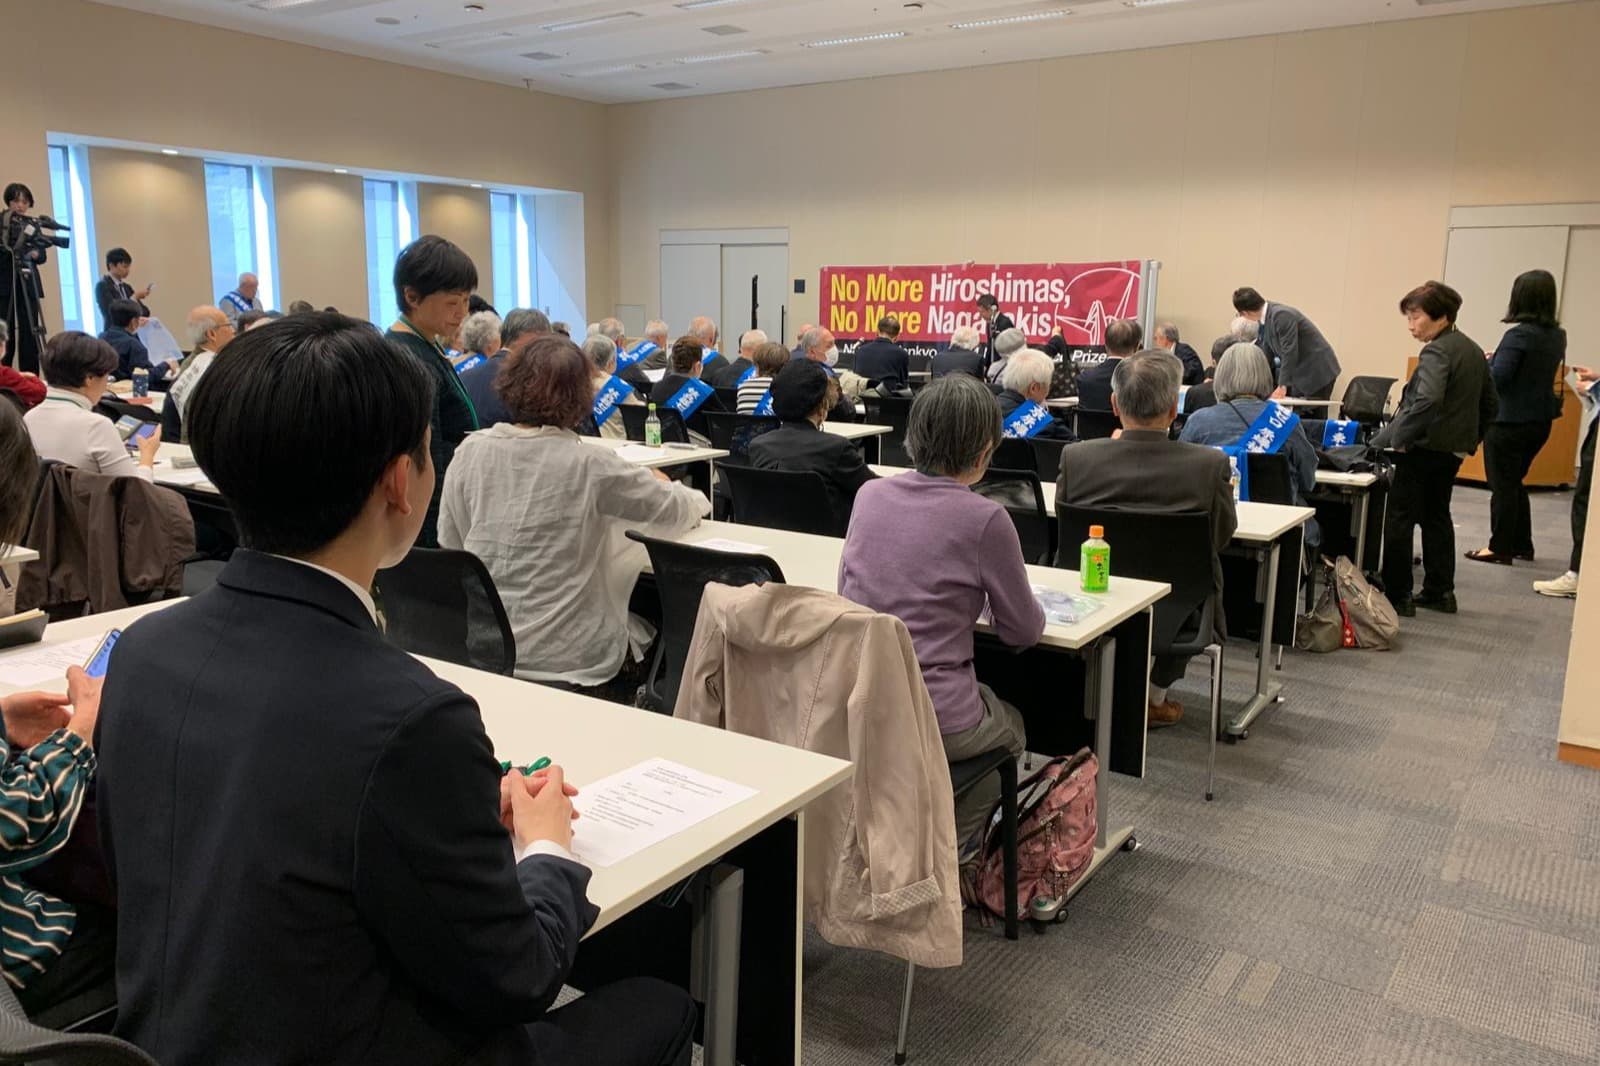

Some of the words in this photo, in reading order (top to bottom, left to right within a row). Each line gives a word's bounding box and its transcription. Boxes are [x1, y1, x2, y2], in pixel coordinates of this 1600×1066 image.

[831, 273, 860, 302] No
[865, 273, 924, 302] More
[930, 272, 1071, 309] Hiroshimas,
[830, 304, 858, 334] No
[864, 304, 921, 334] Mre
[1071, 349, 1108, 363] Prize
